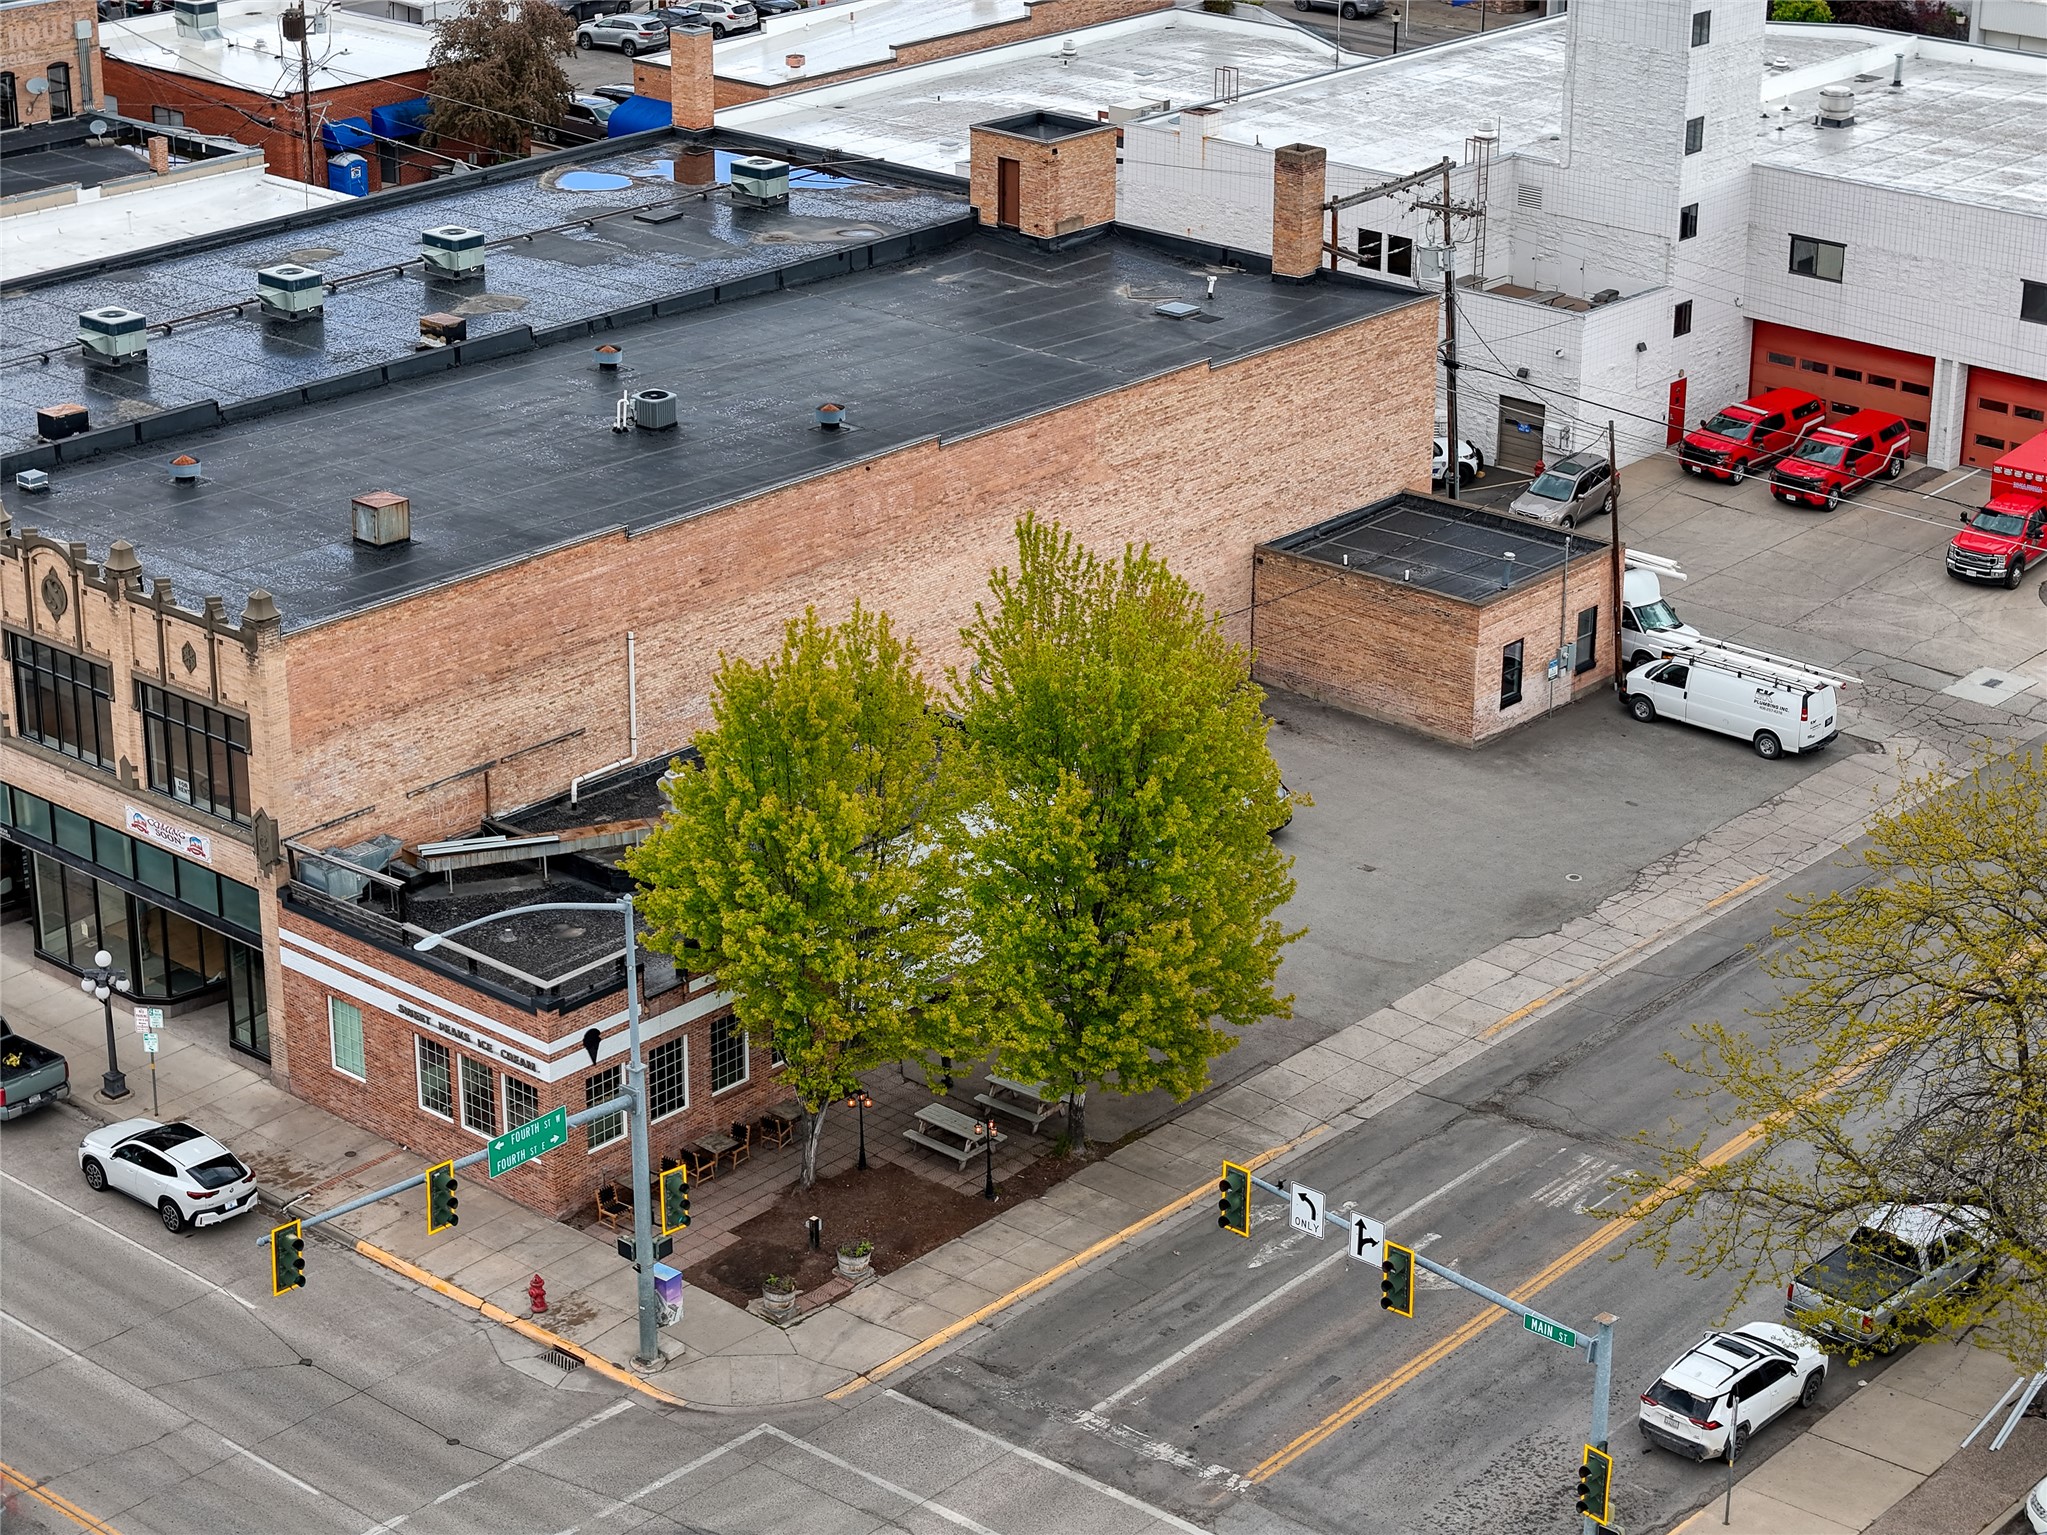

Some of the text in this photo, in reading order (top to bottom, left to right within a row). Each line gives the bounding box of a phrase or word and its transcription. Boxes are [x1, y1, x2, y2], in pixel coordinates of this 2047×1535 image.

[1754, 700, 1778, 710] PLUMBING
[147, 819, 186, 840] COMING
[155, 828, 182, 845] SOON
[397, 1003, 537, 1073] SWEET PEAKS ICE CREAM
[511, 1113, 561, 1145] FOURTH ST W
[497, 1141, 545, 1172] FOURTH ST E
[1295, 1216, 1320, 1232] ONLY
[1531, 1318, 1567, 1343] MAIN ST
